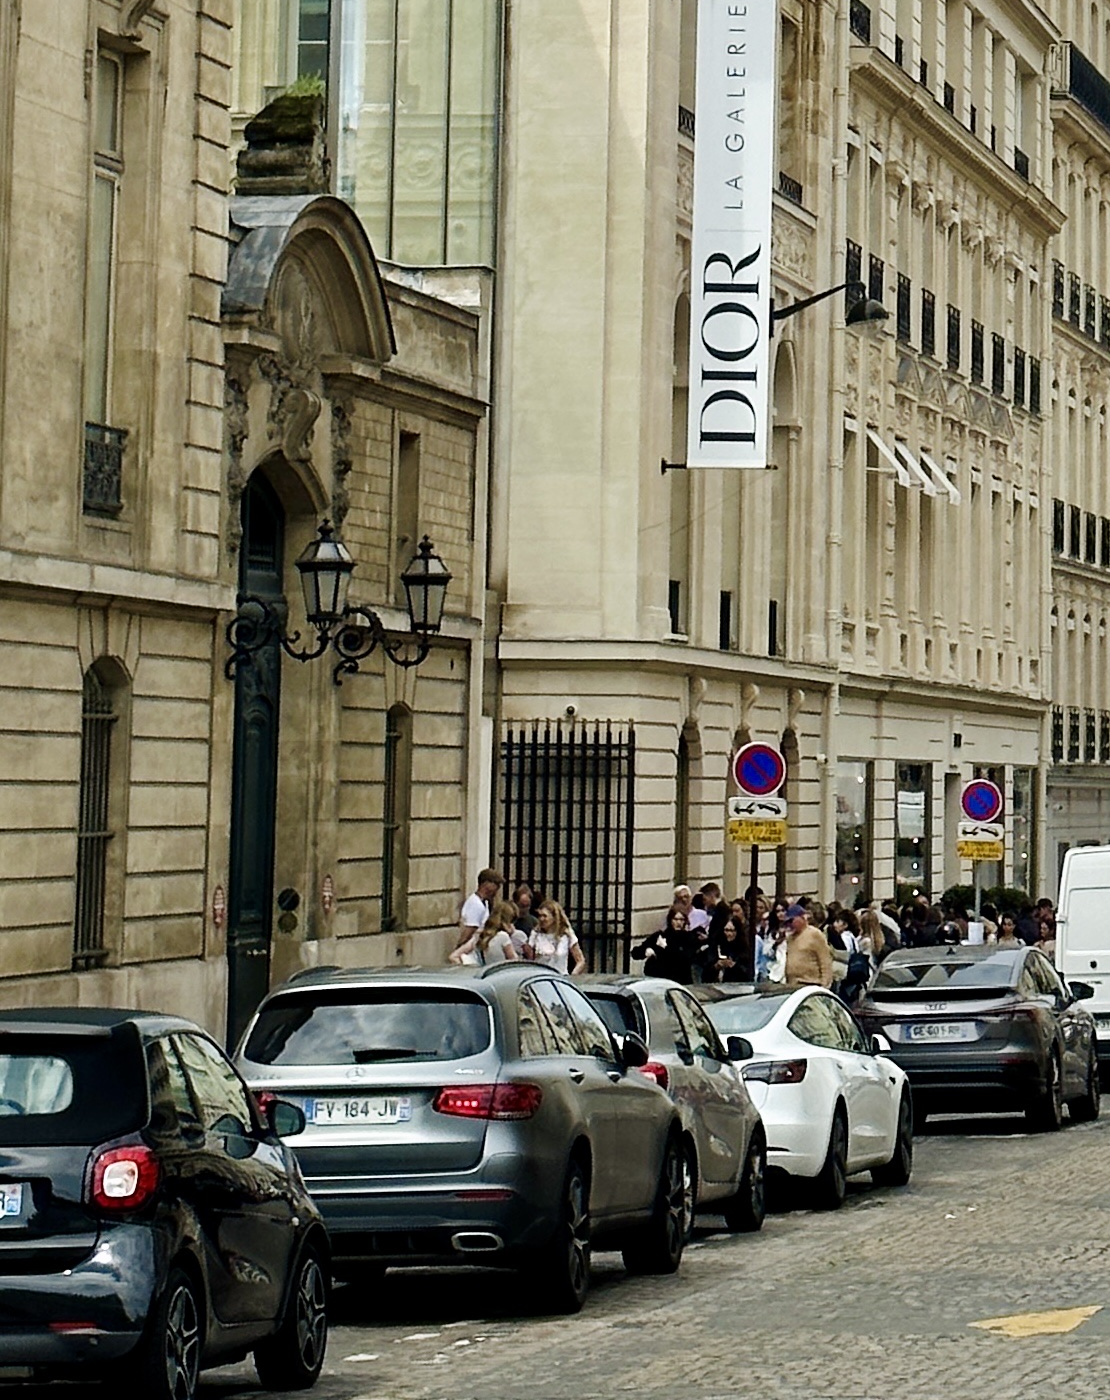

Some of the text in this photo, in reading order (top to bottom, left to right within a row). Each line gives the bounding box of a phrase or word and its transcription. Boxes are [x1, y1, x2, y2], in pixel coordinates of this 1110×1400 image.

[724, 5, 747, 210] LA GALERIE
[699, 243, 762, 450] DIOR
[315, 1097, 400, 1118] FV-184-JW
